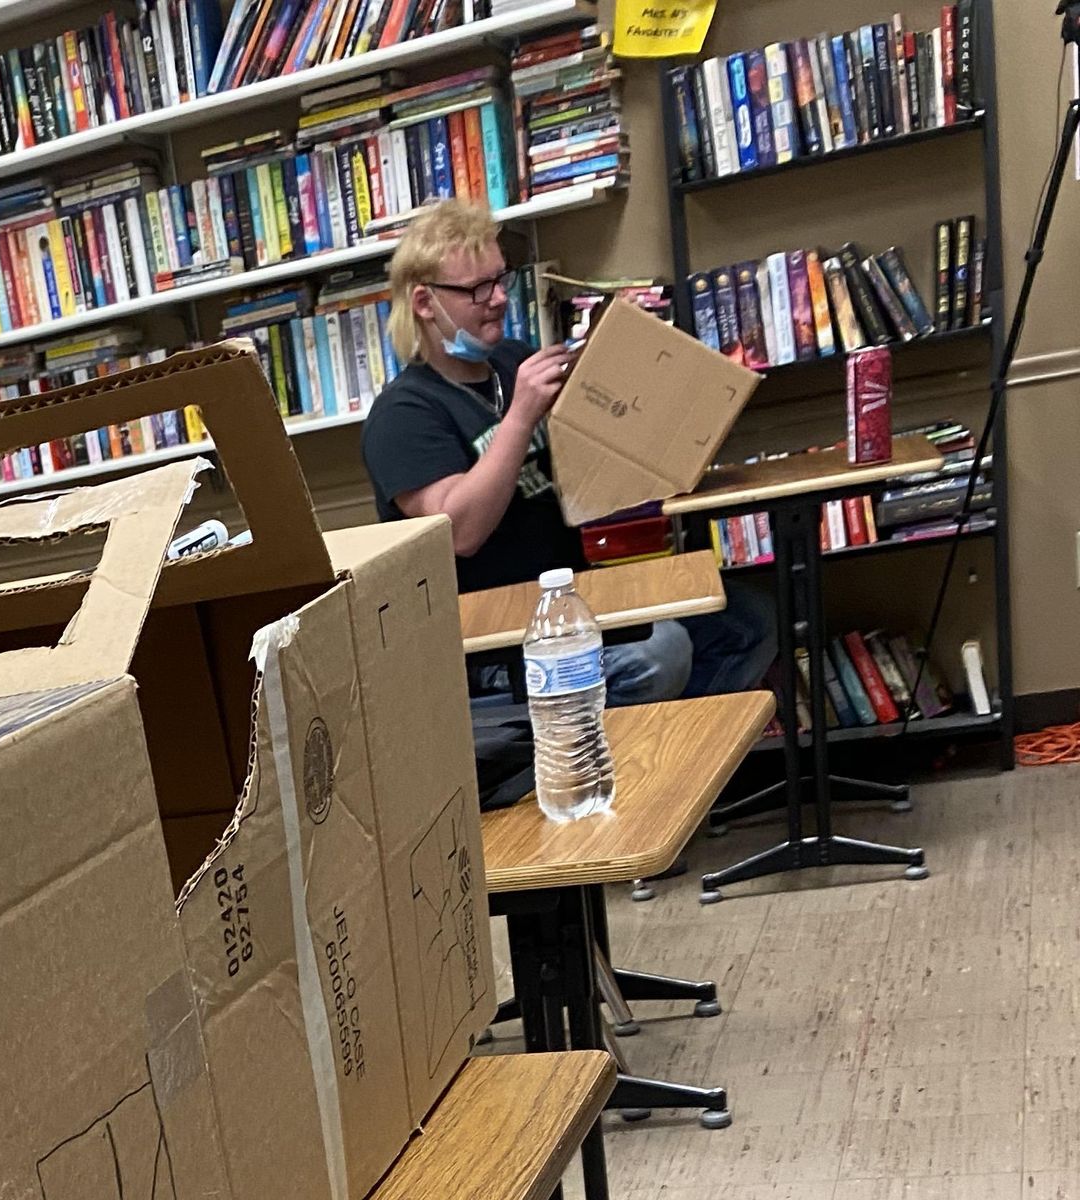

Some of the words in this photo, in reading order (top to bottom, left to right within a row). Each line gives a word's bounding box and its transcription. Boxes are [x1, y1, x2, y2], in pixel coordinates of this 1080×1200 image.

[214, 866, 240, 978] 012420
[325, 940, 354, 1078] 60065599
[333, 905, 357, 1000] JELL-O
[350, 1005, 366, 1083] CASE
